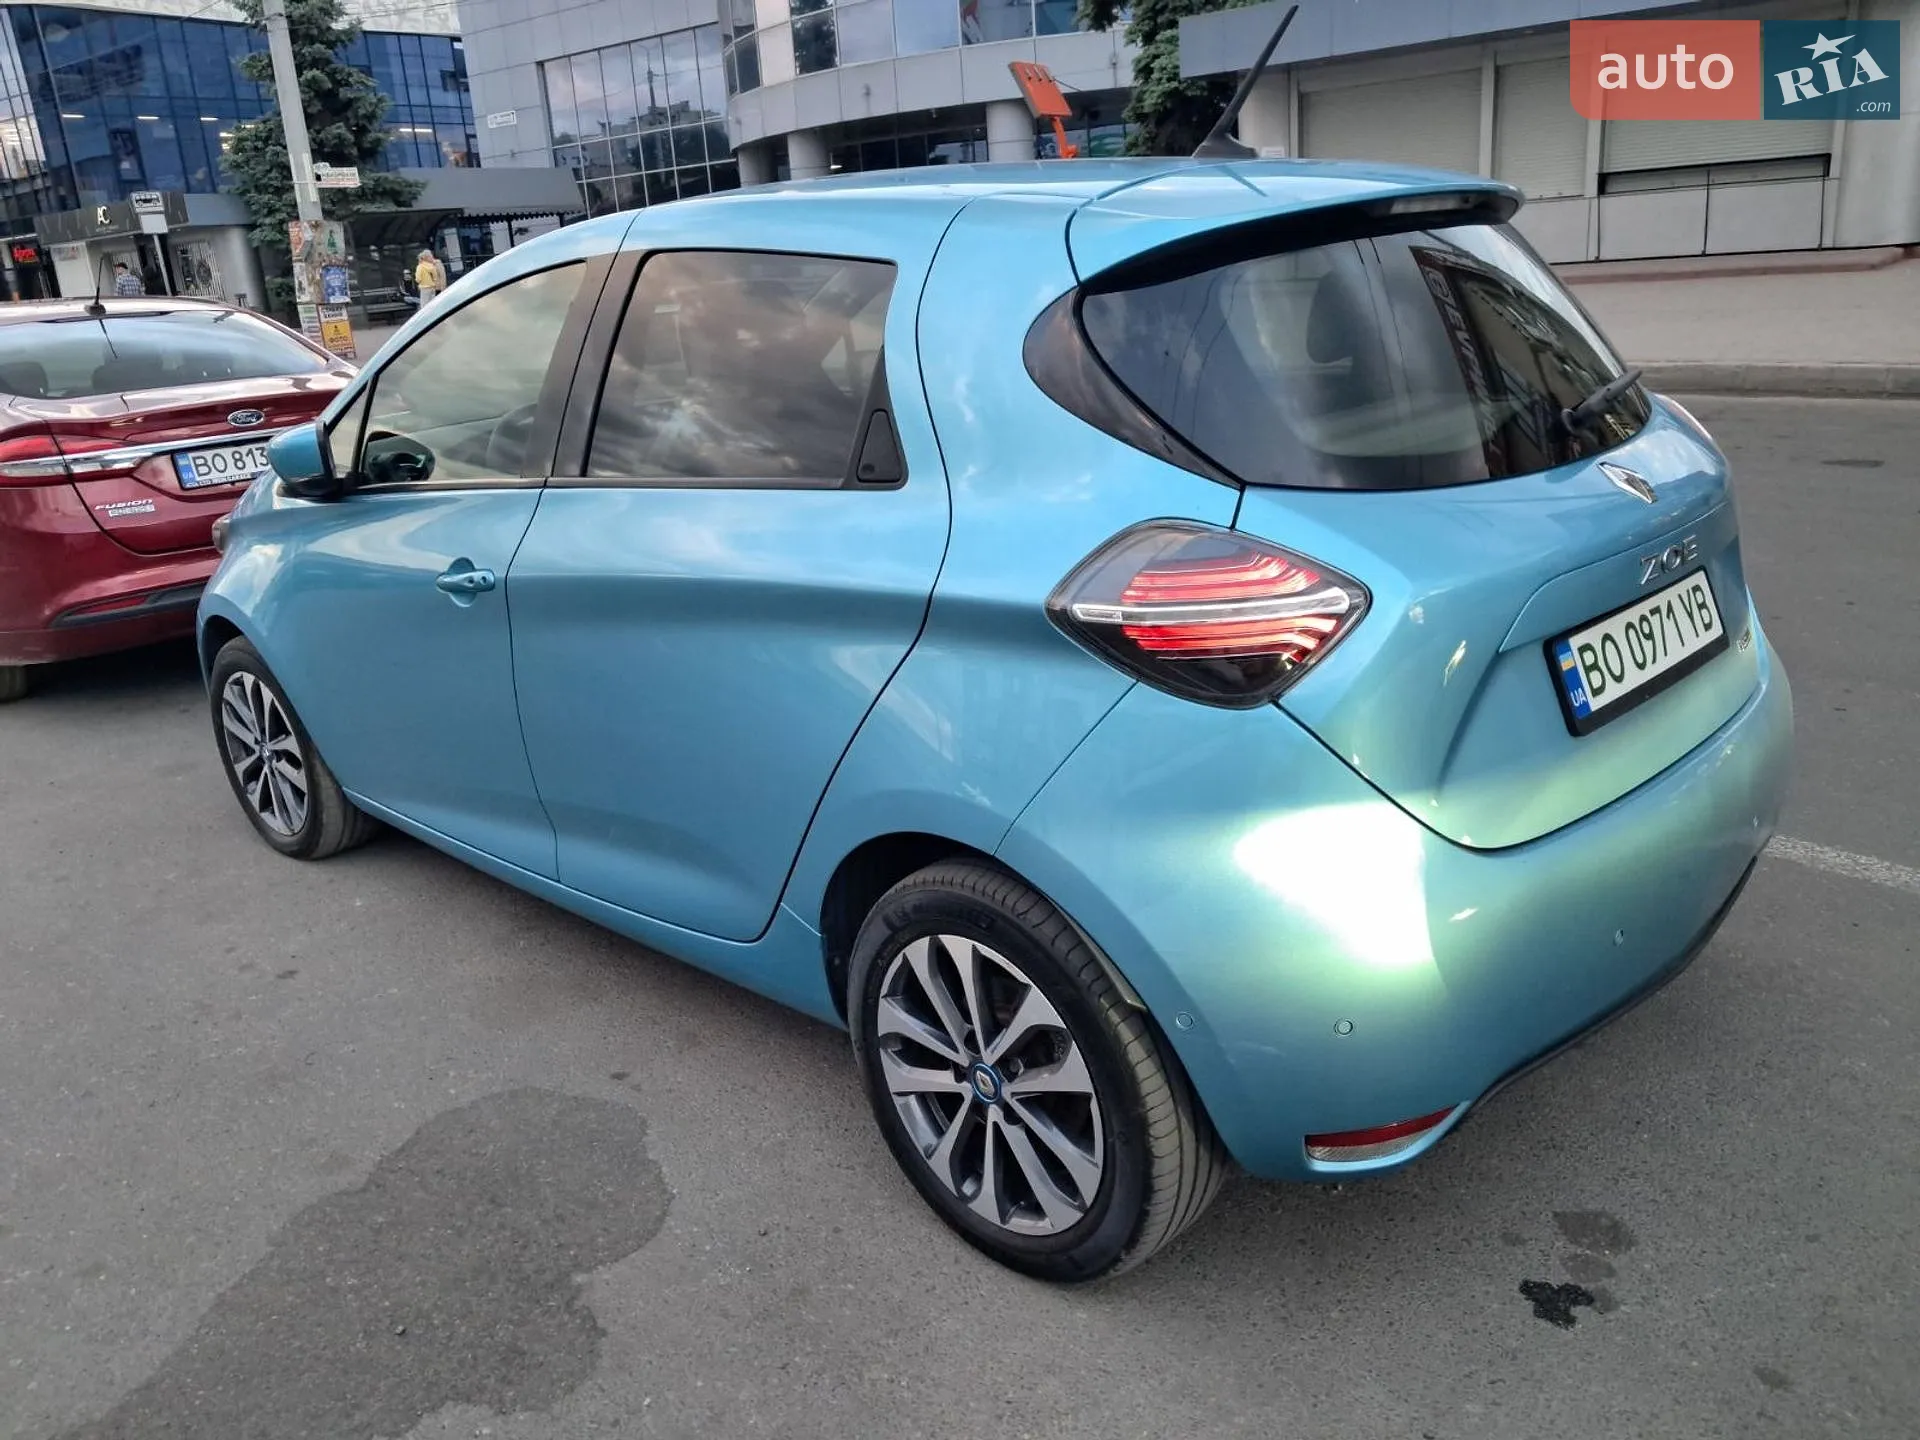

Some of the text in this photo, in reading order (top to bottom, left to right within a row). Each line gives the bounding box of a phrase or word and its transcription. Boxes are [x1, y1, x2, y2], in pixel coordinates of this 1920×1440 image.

[192, 453, 228, 477] BO
[1640, 535, 1698, 585] ZOE
[1577, 584, 1713, 698] BO 0971 YB
[1570, 688, 1588, 707] UA
